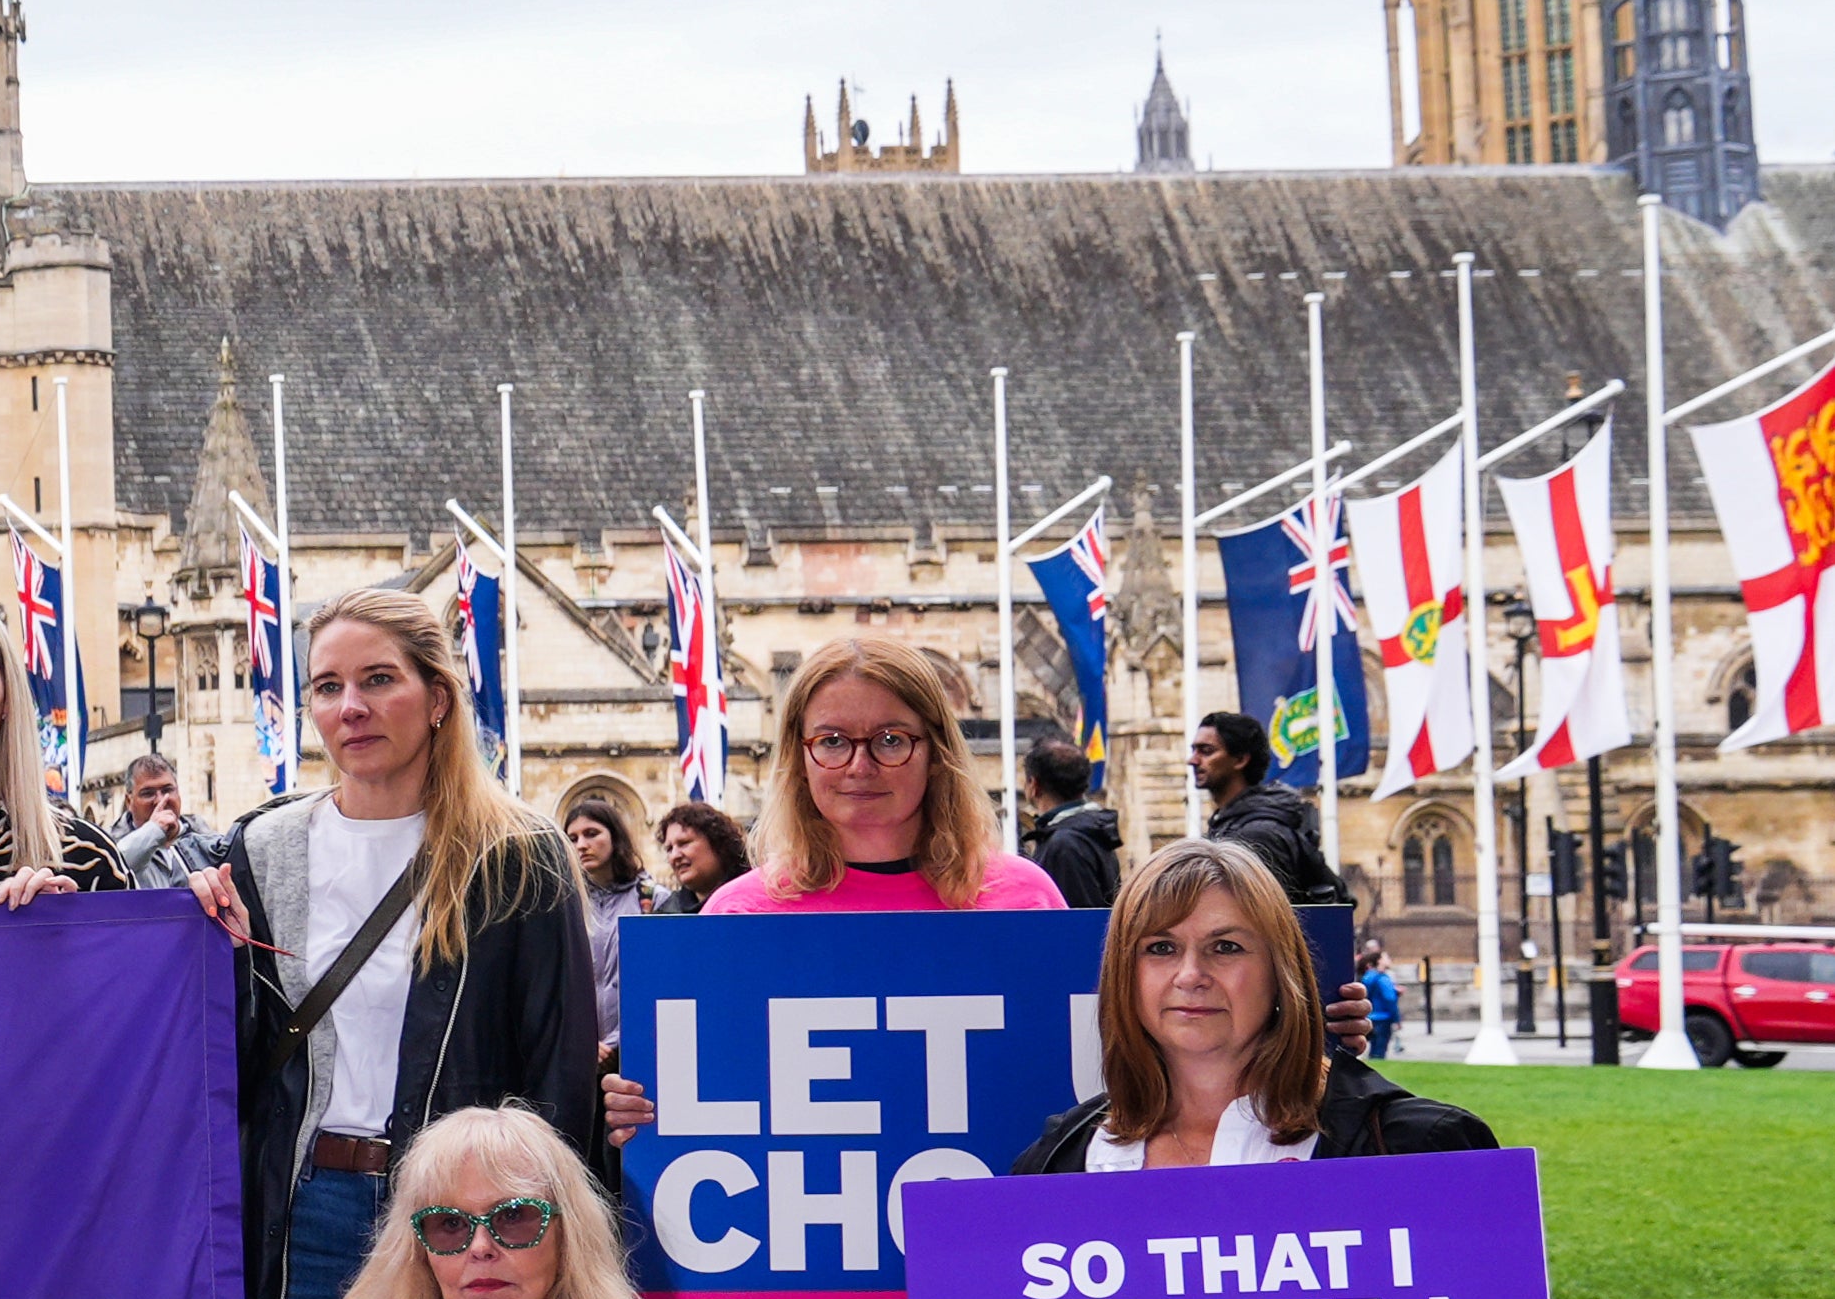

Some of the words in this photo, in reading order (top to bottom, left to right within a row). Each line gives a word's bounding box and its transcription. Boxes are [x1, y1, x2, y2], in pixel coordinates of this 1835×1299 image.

[656, 995, 1005, 1136] LET
[1147, 1230, 1362, 1295] THAT
[1389, 1228, 1413, 1287] I
